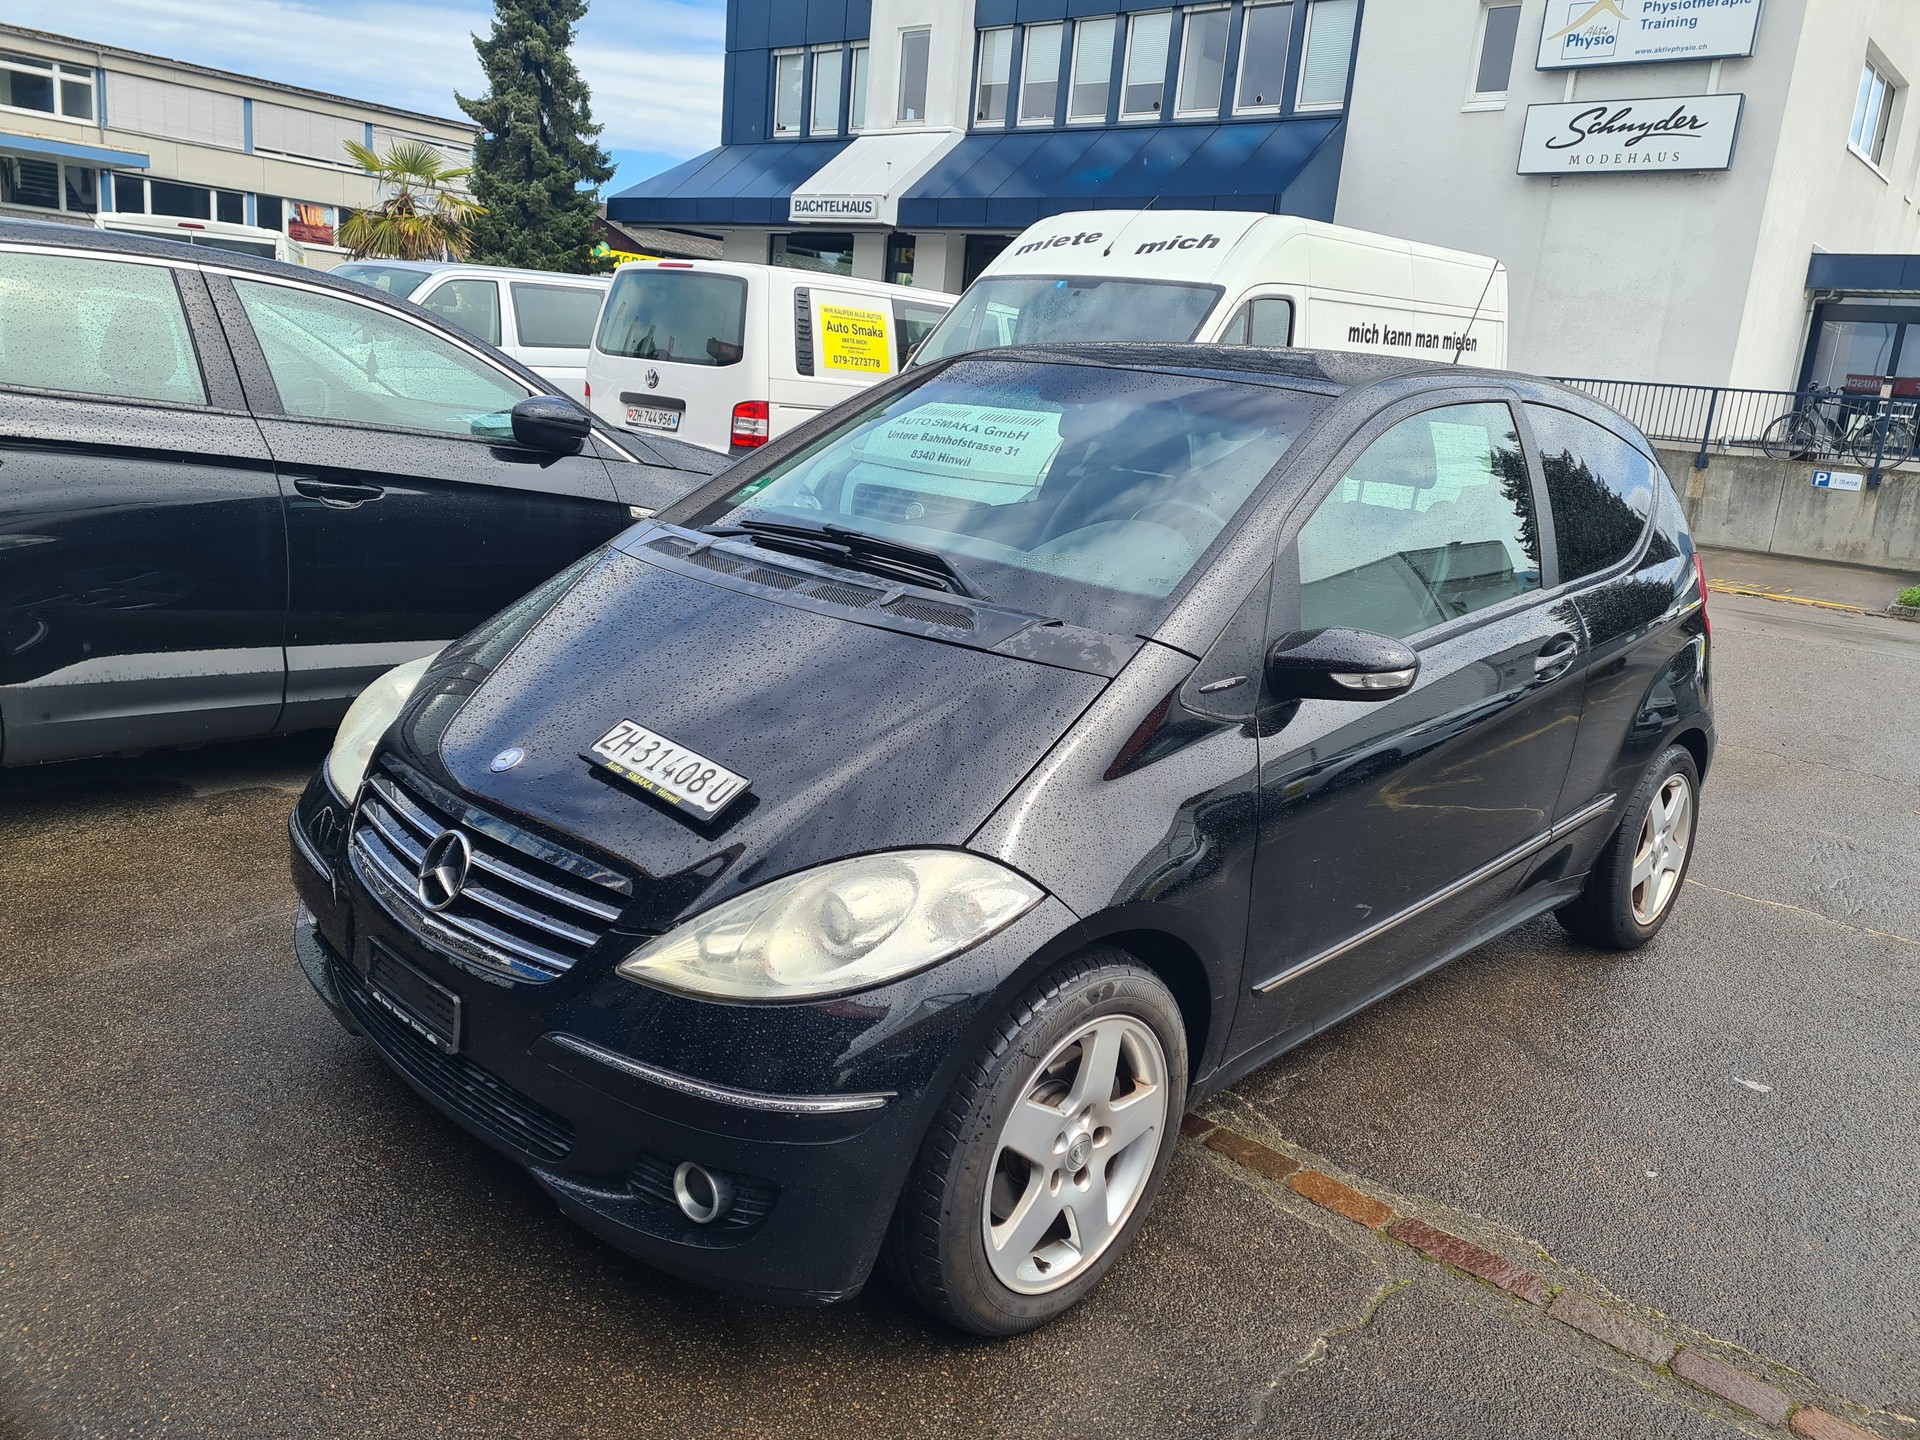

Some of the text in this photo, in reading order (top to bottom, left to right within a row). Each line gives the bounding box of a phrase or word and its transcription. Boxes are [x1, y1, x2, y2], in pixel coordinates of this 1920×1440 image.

[1641, 16, 1698, 30] Training
[1566, 33, 1615, 49] Physio
[1635, 43, 1708, 55] www.aktivphysio.ch
[1545, 105, 1709, 149] Schnyder
[1569, 152, 1681, 165] MODEHAUS
[794, 200, 872, 213] BACHTELHAUS
[1014, 228, 1221, 257] miete mich
[834, 309, 853, 317] KAUFEN
[826, 320, 883, 338] Auto Smaka
[1348, 322, 1477, 352] mich kann man mieten
[833, 355, 881, 368] 079-7273778
[896, 416, 1029, 441] AUTO SMAKA GmbH
[887, 430, 1020, 457] Untere Bahnhofstrasse 31
[910, 449, 971, 467] 8340 Hinwil
[604, 761, 682, 805] Auto SMAKA Hinwil
